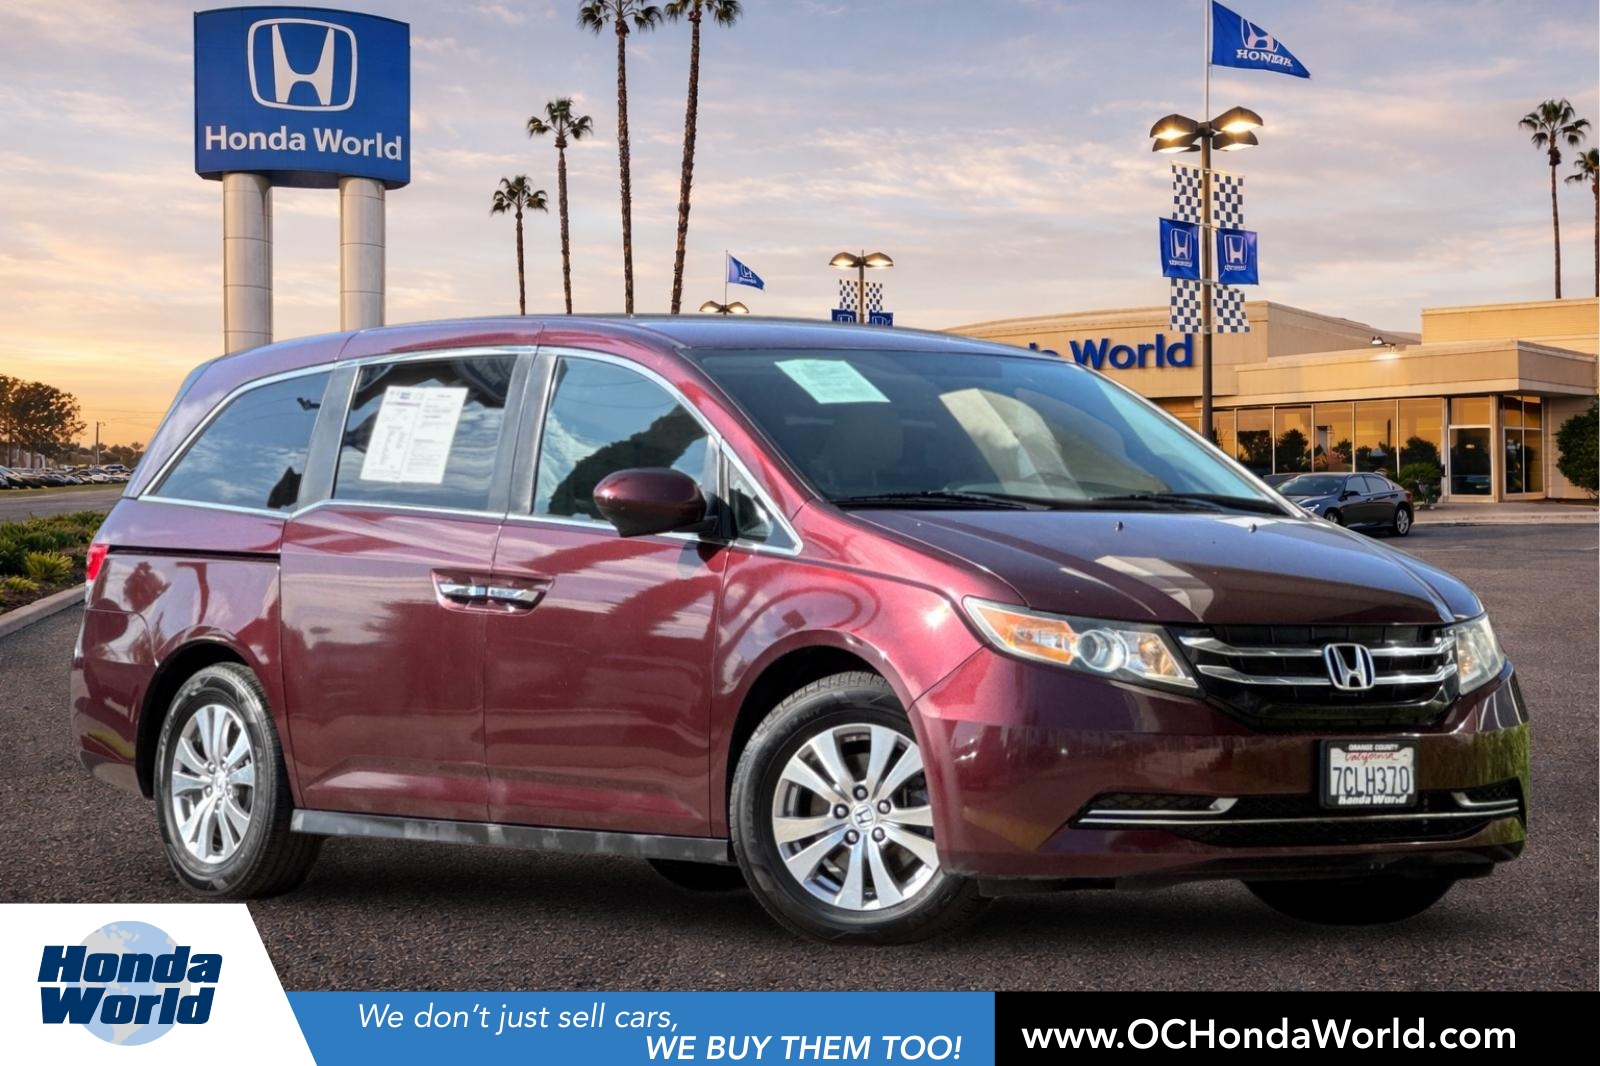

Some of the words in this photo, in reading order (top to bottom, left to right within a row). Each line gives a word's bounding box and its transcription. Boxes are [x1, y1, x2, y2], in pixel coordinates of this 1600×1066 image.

[205, 125, 306, 151] Honda
[312, 127, 402, 161] World
[1069, 333, 1193, 370] World
[1332, 766, 1410, 795] 7CLH370
[1338, 795, 1371, 805] Honda
[1373, 795, 1407, 805] World
